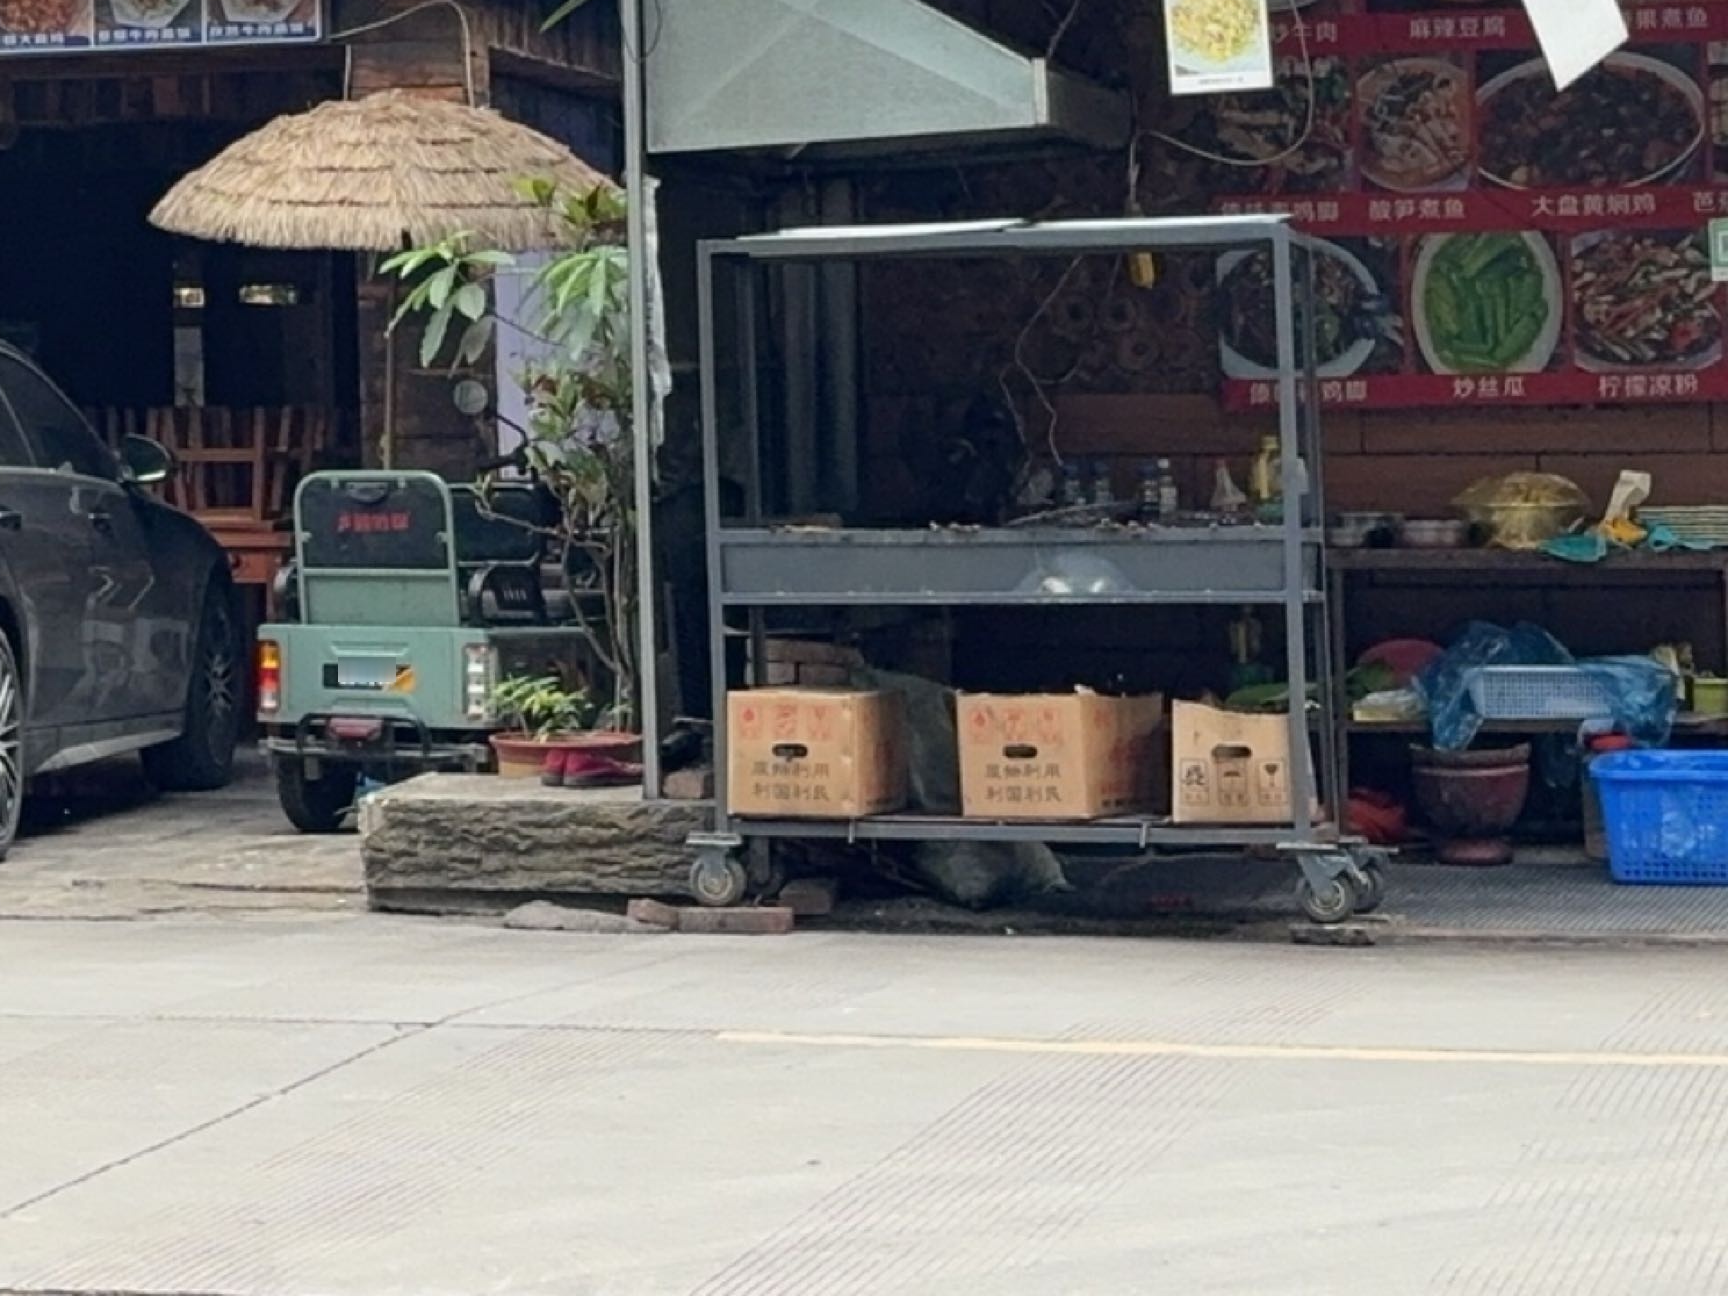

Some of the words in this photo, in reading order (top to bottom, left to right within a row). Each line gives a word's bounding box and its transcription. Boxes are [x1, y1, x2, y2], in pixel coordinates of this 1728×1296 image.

[1531, 192, 1656, 216] 大盘黄焖鸡
[1453, 375, 1525, 398] 炒丝瓜
[1598, 374, 1699, 398] 柠檬凉粉
